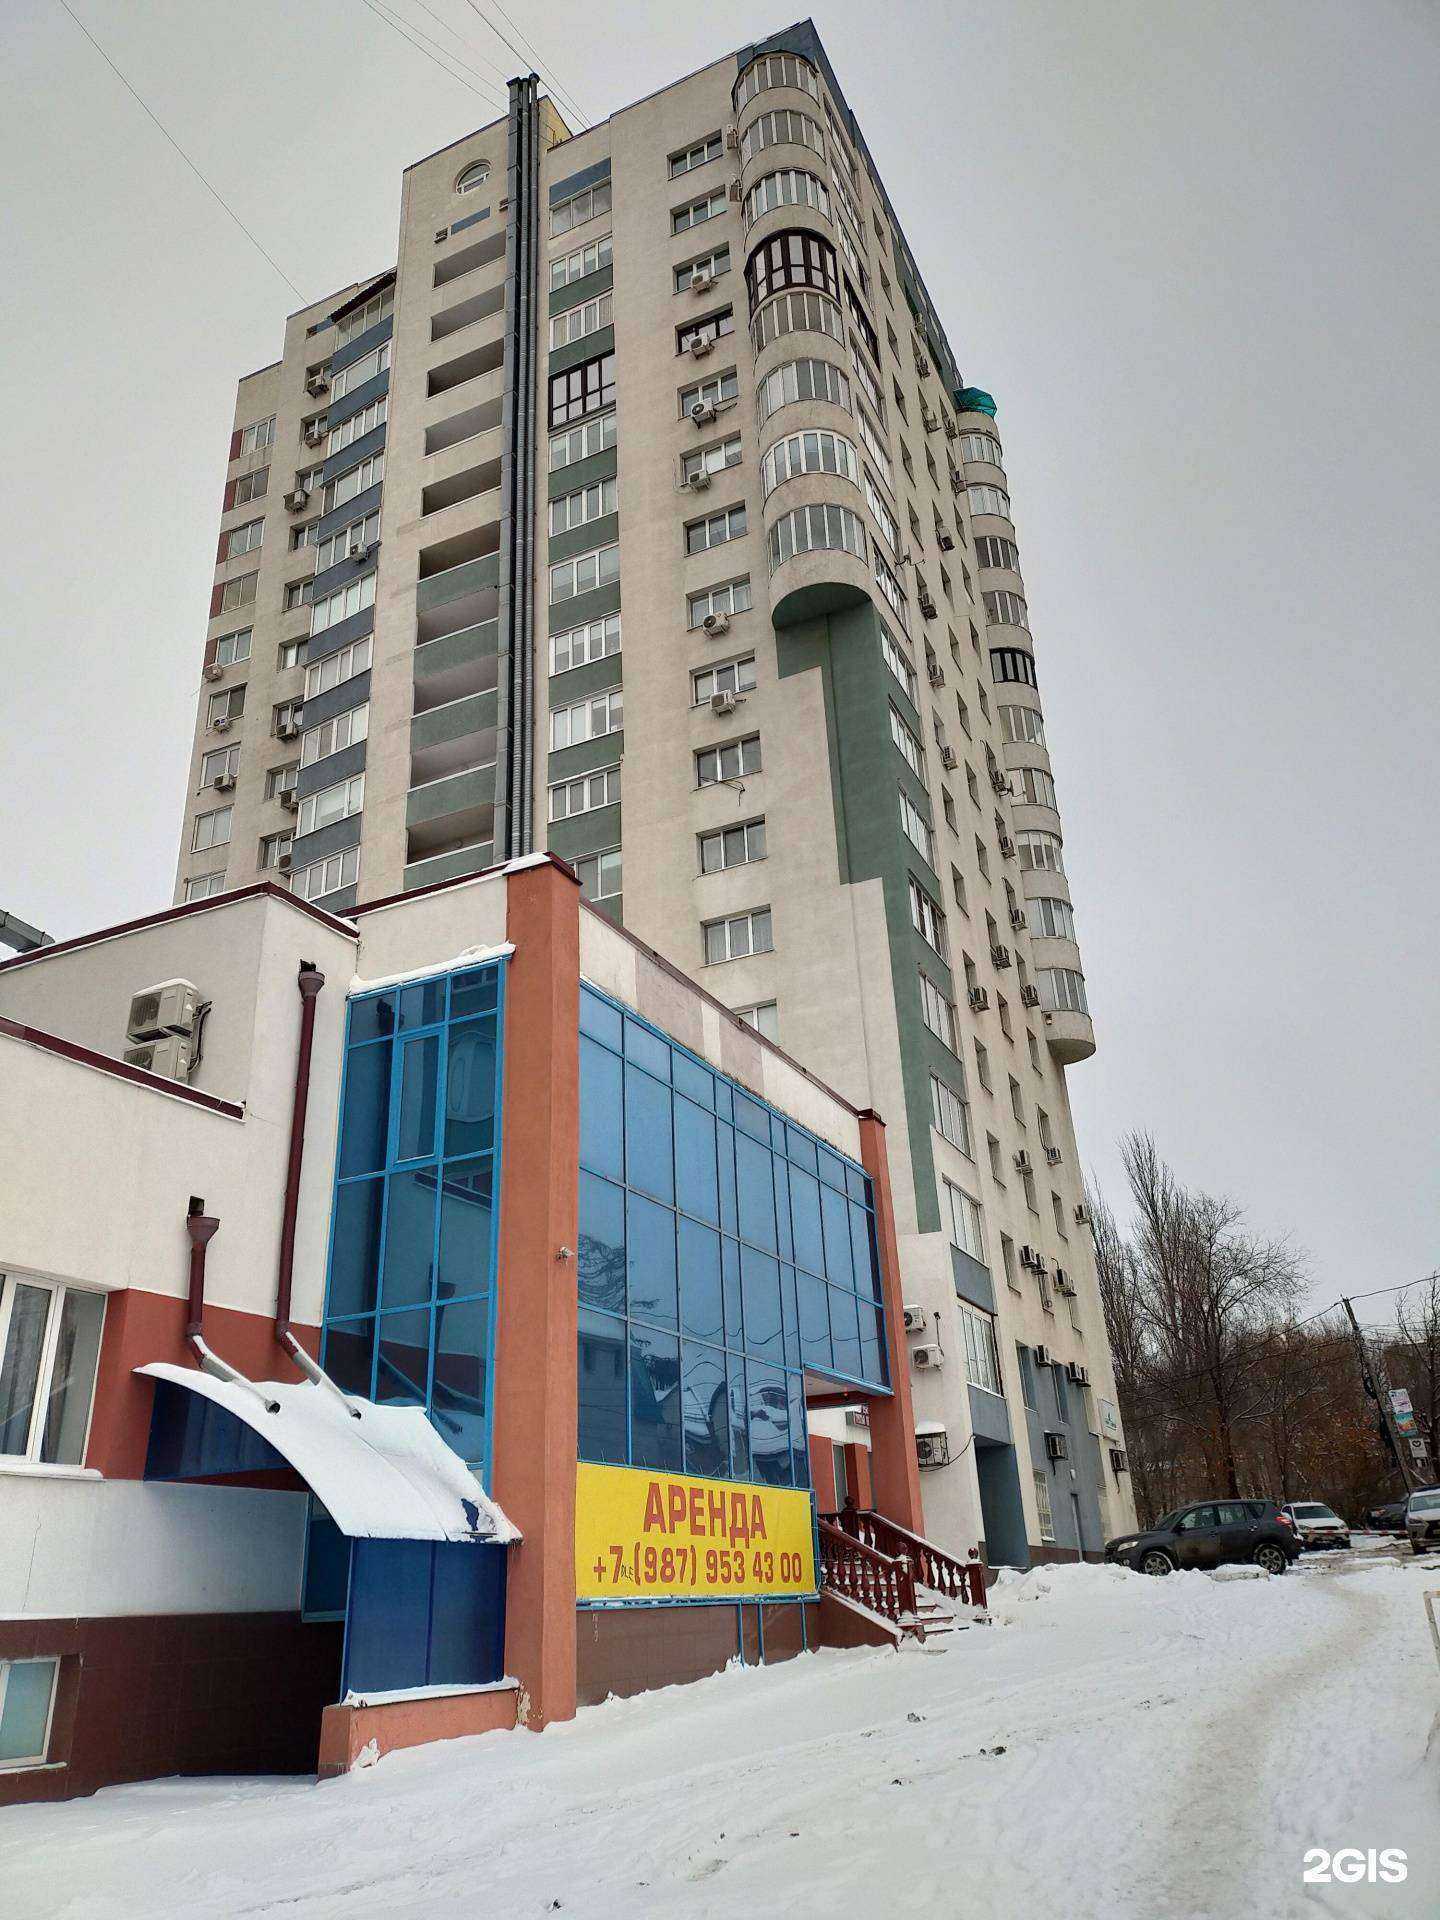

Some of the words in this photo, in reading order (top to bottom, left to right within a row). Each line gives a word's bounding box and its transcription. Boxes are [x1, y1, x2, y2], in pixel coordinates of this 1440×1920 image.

[643, 1481, 768, 1549] АРЕНДА
[706, 1549, 746, 1584] 953
[752, 1550, 774, 1584] 43
[779, 1552, 803, 1584] 00
